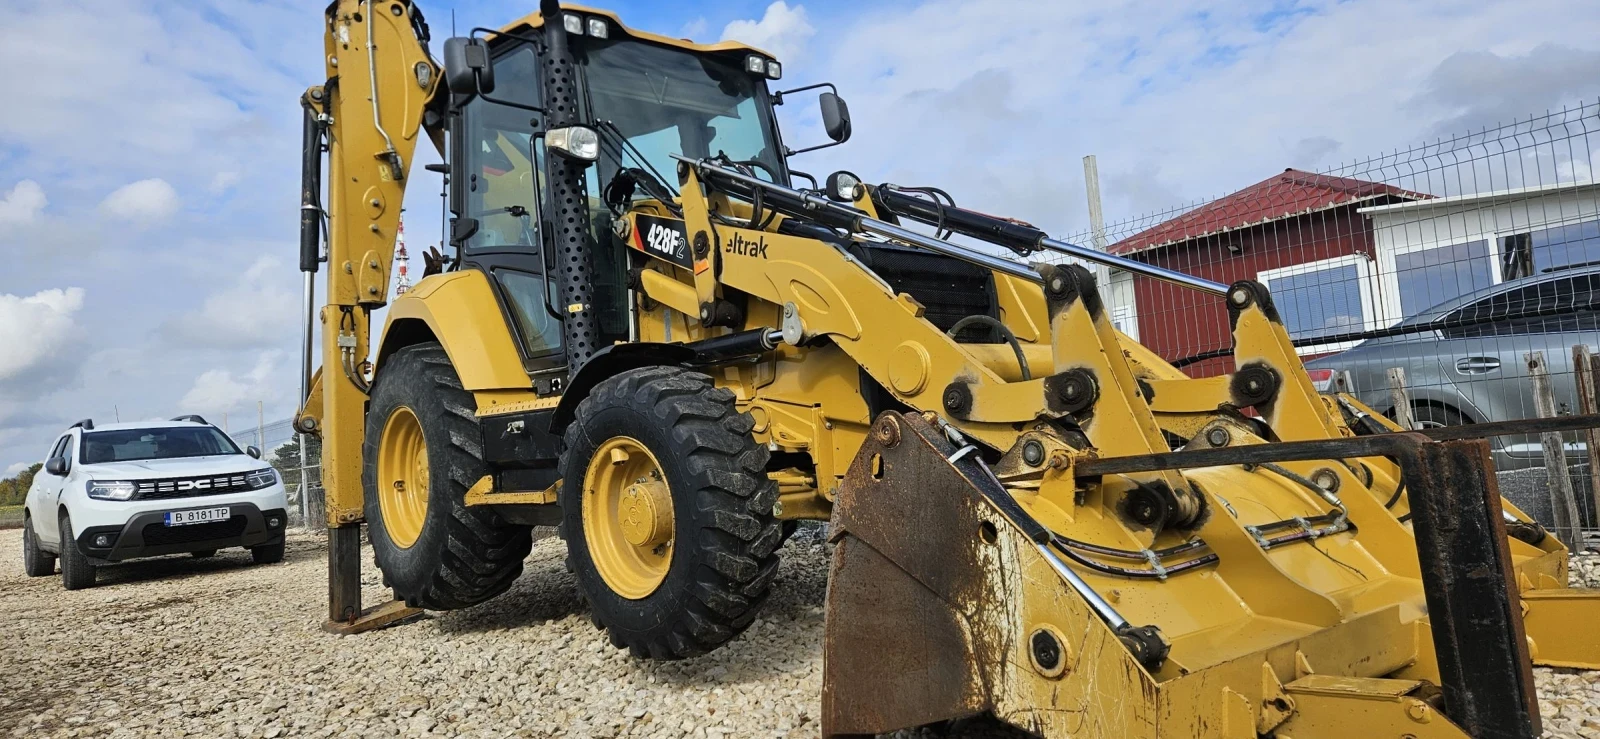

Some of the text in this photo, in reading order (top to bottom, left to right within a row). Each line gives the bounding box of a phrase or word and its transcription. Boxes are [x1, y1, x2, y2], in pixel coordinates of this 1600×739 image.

[725, 232, 768, 259] eltrak
[175, 513, 182, 522] B
[188, 510, 212, 520] 8181
[215, 508, 228, 518] TP
